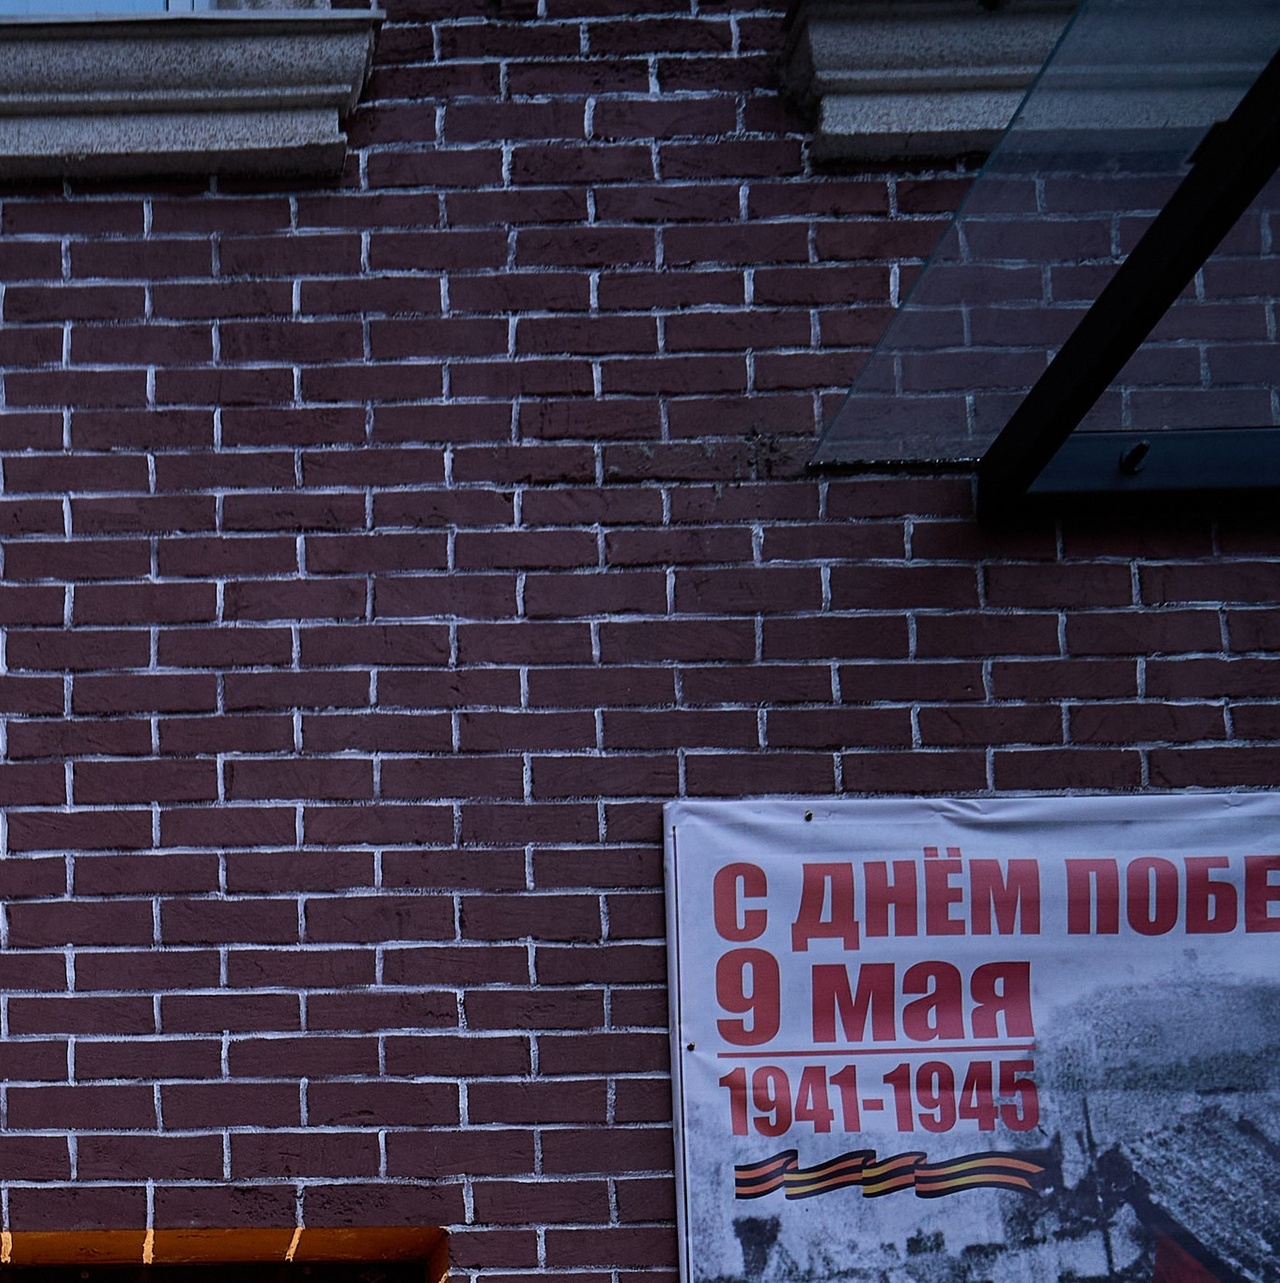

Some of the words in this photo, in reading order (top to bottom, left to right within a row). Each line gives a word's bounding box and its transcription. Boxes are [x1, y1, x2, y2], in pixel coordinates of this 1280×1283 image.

[713, 862, 768, 942] С
[791, 847, 1041, 951] ДНЁМ
[1065, 855, 1280, 936] ПОБЕ
[715, 948, 780, 1046] 9
[812, 961, 1035, 1043] мая
[720, 1060, 1040, 1137] 1941-1945
